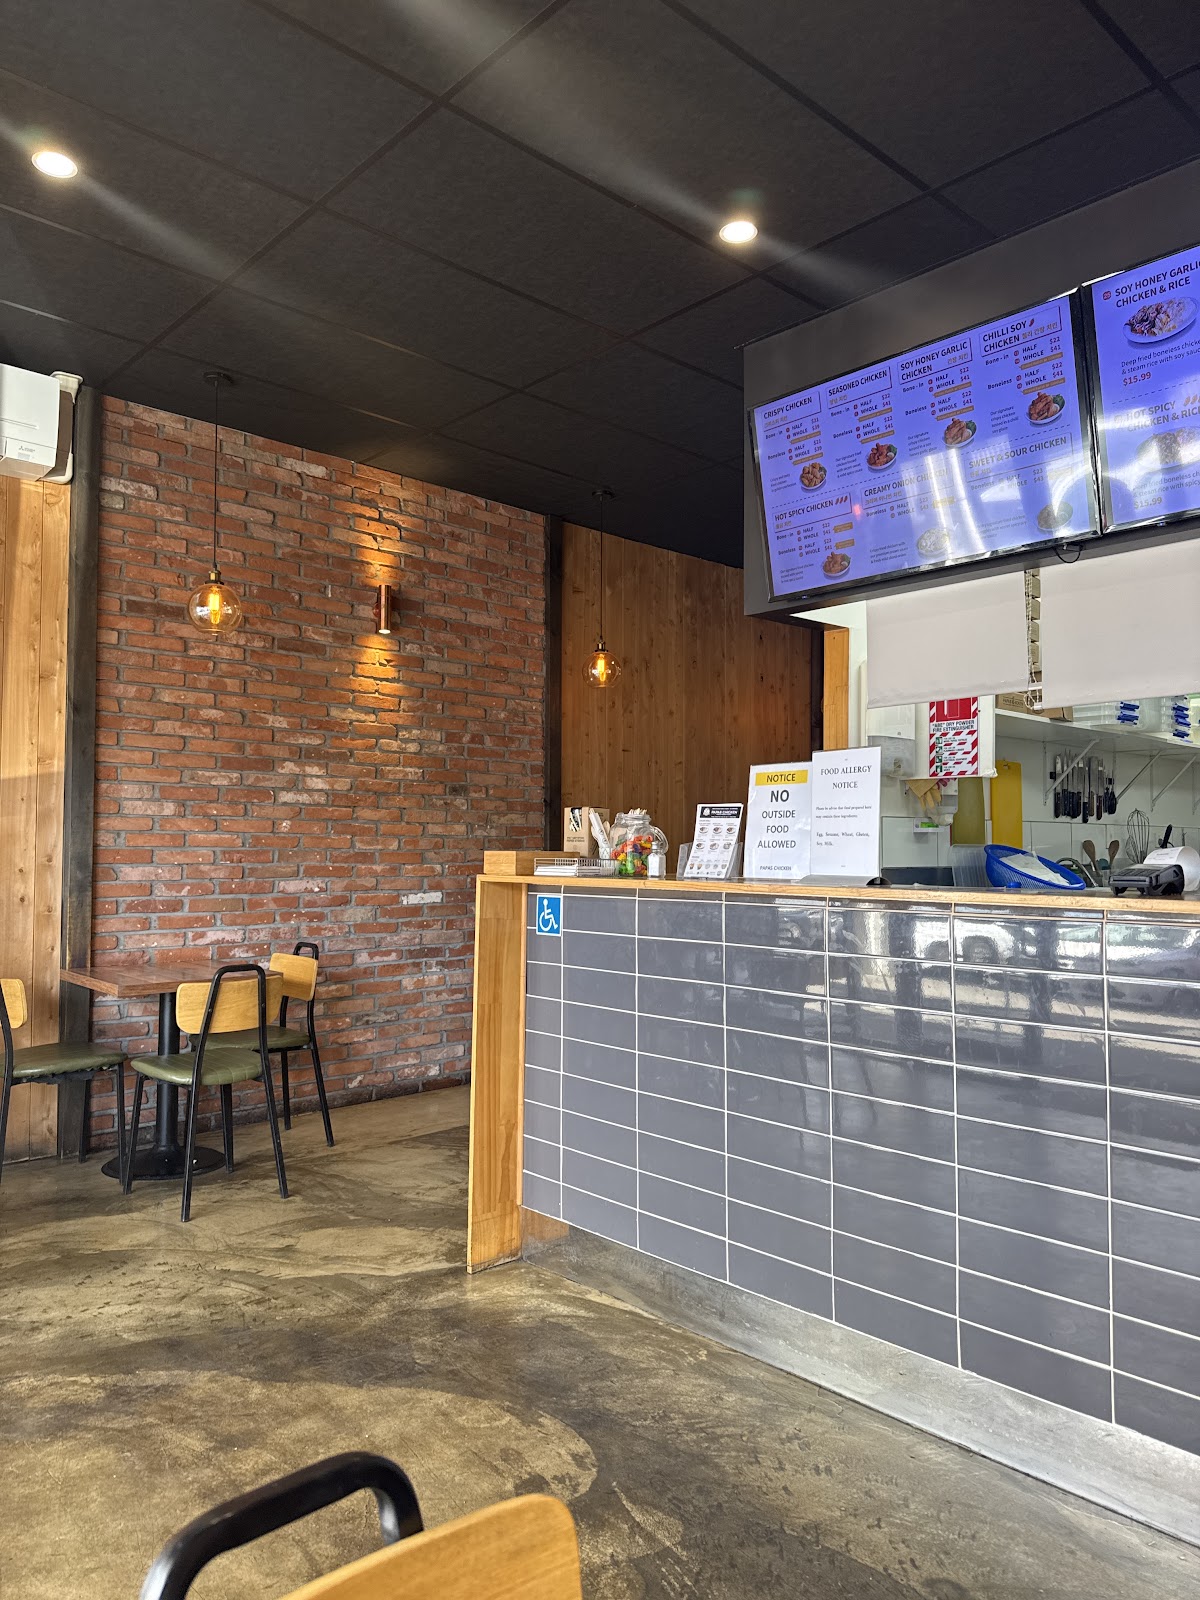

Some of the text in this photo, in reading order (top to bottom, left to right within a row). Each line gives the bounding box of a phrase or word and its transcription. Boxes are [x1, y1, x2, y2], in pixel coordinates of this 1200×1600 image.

[1115, 260, 1200, 297] SOY HONEY GARLI
[1116, 276, 1191, 308] CHICKEN & RICE
[982, 320, 1027, 342] CHILLI SOY
[1046, 321, 1058, 332] 치킨
[983, 334, 1020, 353] CHICKEN
[1022, 336, 1060, 354] HALF $22
[900, 341, 968, 371] SOY HONEY GARLIC
[1023, 350, 1044, 362] WHOLE
[1050, 345, 1061, 353] $41
[1121, 358, 1137, 368] Deep
[1137, 353, 1152, 363] fried
[1153, 345, 1181, 358] boneless
[1127, 363, 1146, 374] steam
[1158, 354, 1173, 364] with
[1174, 352, 1185, 361] soy
[901, 364, 933, 381] CHICKEN
[935, 366, 969, 382] HALF $22
[1024, 362, 1063, 379] HALF $22
[828, 369, 887, 396] SEASONED CHICKEN
[936, 379, 955, 390] WHOLE
[960, 374, 970, 382] $41
[987, 378, 1012, 390] Boneless
[1025, 375, 1047, 387] WHOLE
[1052, 370, 1063, 379] $41
[1122, 371, 1151, 387] $15.99
[860, 393, 890, 407] HALF $22
[937, 390, 971, 406] HALF $22
[763, 406, 785, 419] CRISPY
[785, 396, 812, 412] CHICKEN
[861, 405, 878, 414] WHOLE
[905, 405, 927, 416] Boneless
[938, 403, 957, 413] WHOLE
[962, 398, 972, 406] $41
[1126, 409, 1145, 423] HOT
[1148, 401, 1176, 416] SPICY
[791, 422, 803, 430] HALF
[862, 422, 874, 430] HALF
[1127, 414, 1170, 432] CHICKEN
[1171, 412, 1179, 421] &
[792, 428, 808, 437] WHOLE
[833, 429, 853, 439] Boneless
[863, 427, 880, 437] WHOLE
[794, 443, 805, 451] HALF
[795, 449, 810, 458] WHOLE
[969, 436, 1067, 469] SWEET & SOUR CHICKEN
[767, 451, 786, 460] Boneless
[1033, 468, 1043, 476] $23
[1163, 471, 1191, 484] boneless
[863, 485, 891, 497] CREAMY
[892, 476, 915, 489] ONION
[1170, 480, 1184, 490] with
[1133, 496, 1163, 510] $15.99
[774, 499, 833, 522] HOT SPICY CHICKEN
[866, 508, 887, 517] Boneless
[897, 508, 915, 516] WHOLE
[803, 532, 819, 540] WHOLE
[805, 548, 821, 556] WHOLE
[942, 724, 974, 732] EXTINGUISHER
[820, 765, 873, 776] FOOD ALLERGY
[766, 773, 796, 783] NOTICE
[832, 781, 859, 790] NOTICE
[770, 789, 790, 803] NO
[761, 810, 796, 819] OUTSIDE
[766, 825, 790, 834] FOOD
[757, 839, 797, 849] ALLOWED
